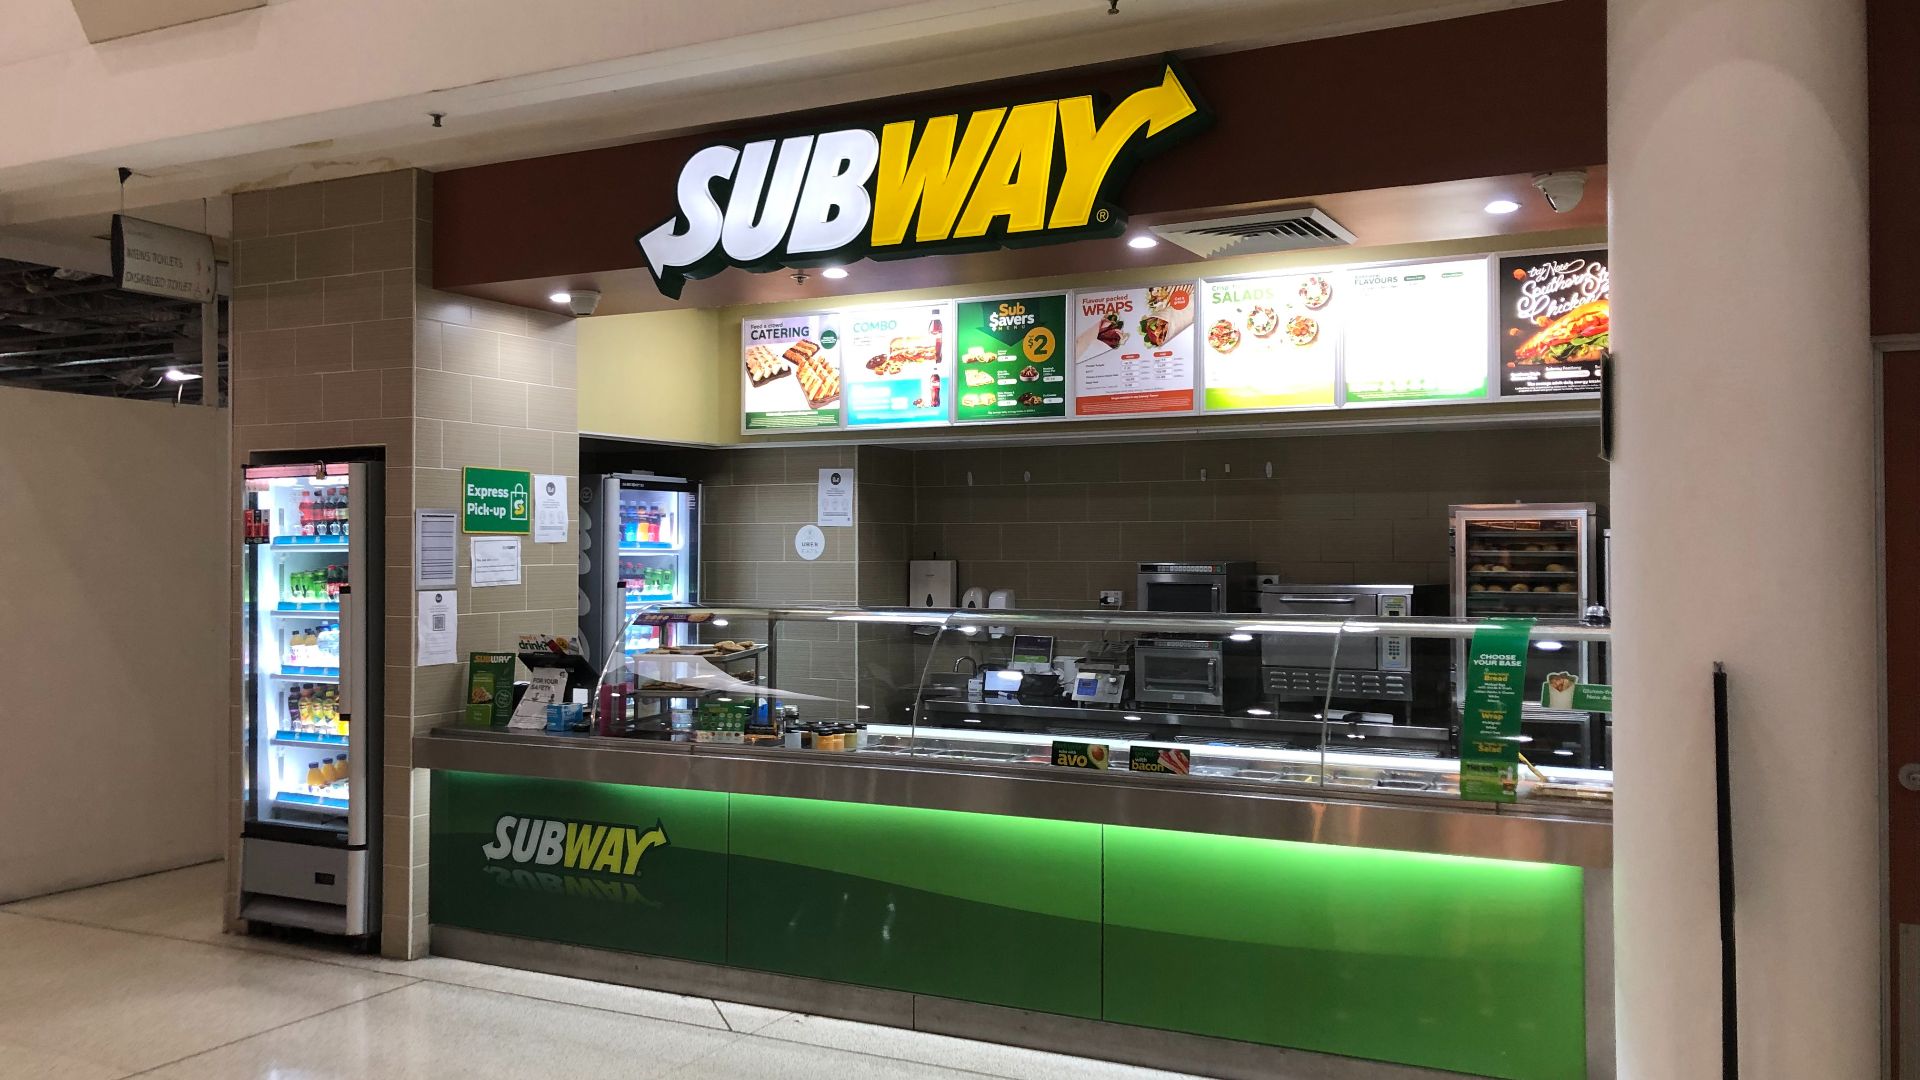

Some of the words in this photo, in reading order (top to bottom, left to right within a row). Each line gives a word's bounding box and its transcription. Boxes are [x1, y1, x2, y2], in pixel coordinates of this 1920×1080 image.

[640, 64, 1197, 280] SUBWAY
[1106, 294, 1128, 302] packed
[1212, 287, 1274, 304] SALADS
[999, 303, 1026, 317] Sub
[1083, 301, 1133, 316] WRAPS
[751, 327, 810, 340] CATERING
[853, 320, 897, 333] COMBO
[467, 483, 509, 500] Express
[467, 502, 507, 519] Pick-up
[519, 640, 548, 651] drink?
[474, 655, 512, 663] SUBWAY
[1057, 753, 1088, 768] avo
[1131, 759, 1164, 772] bacon
[482, 815, 667, 875] SUBWAY
